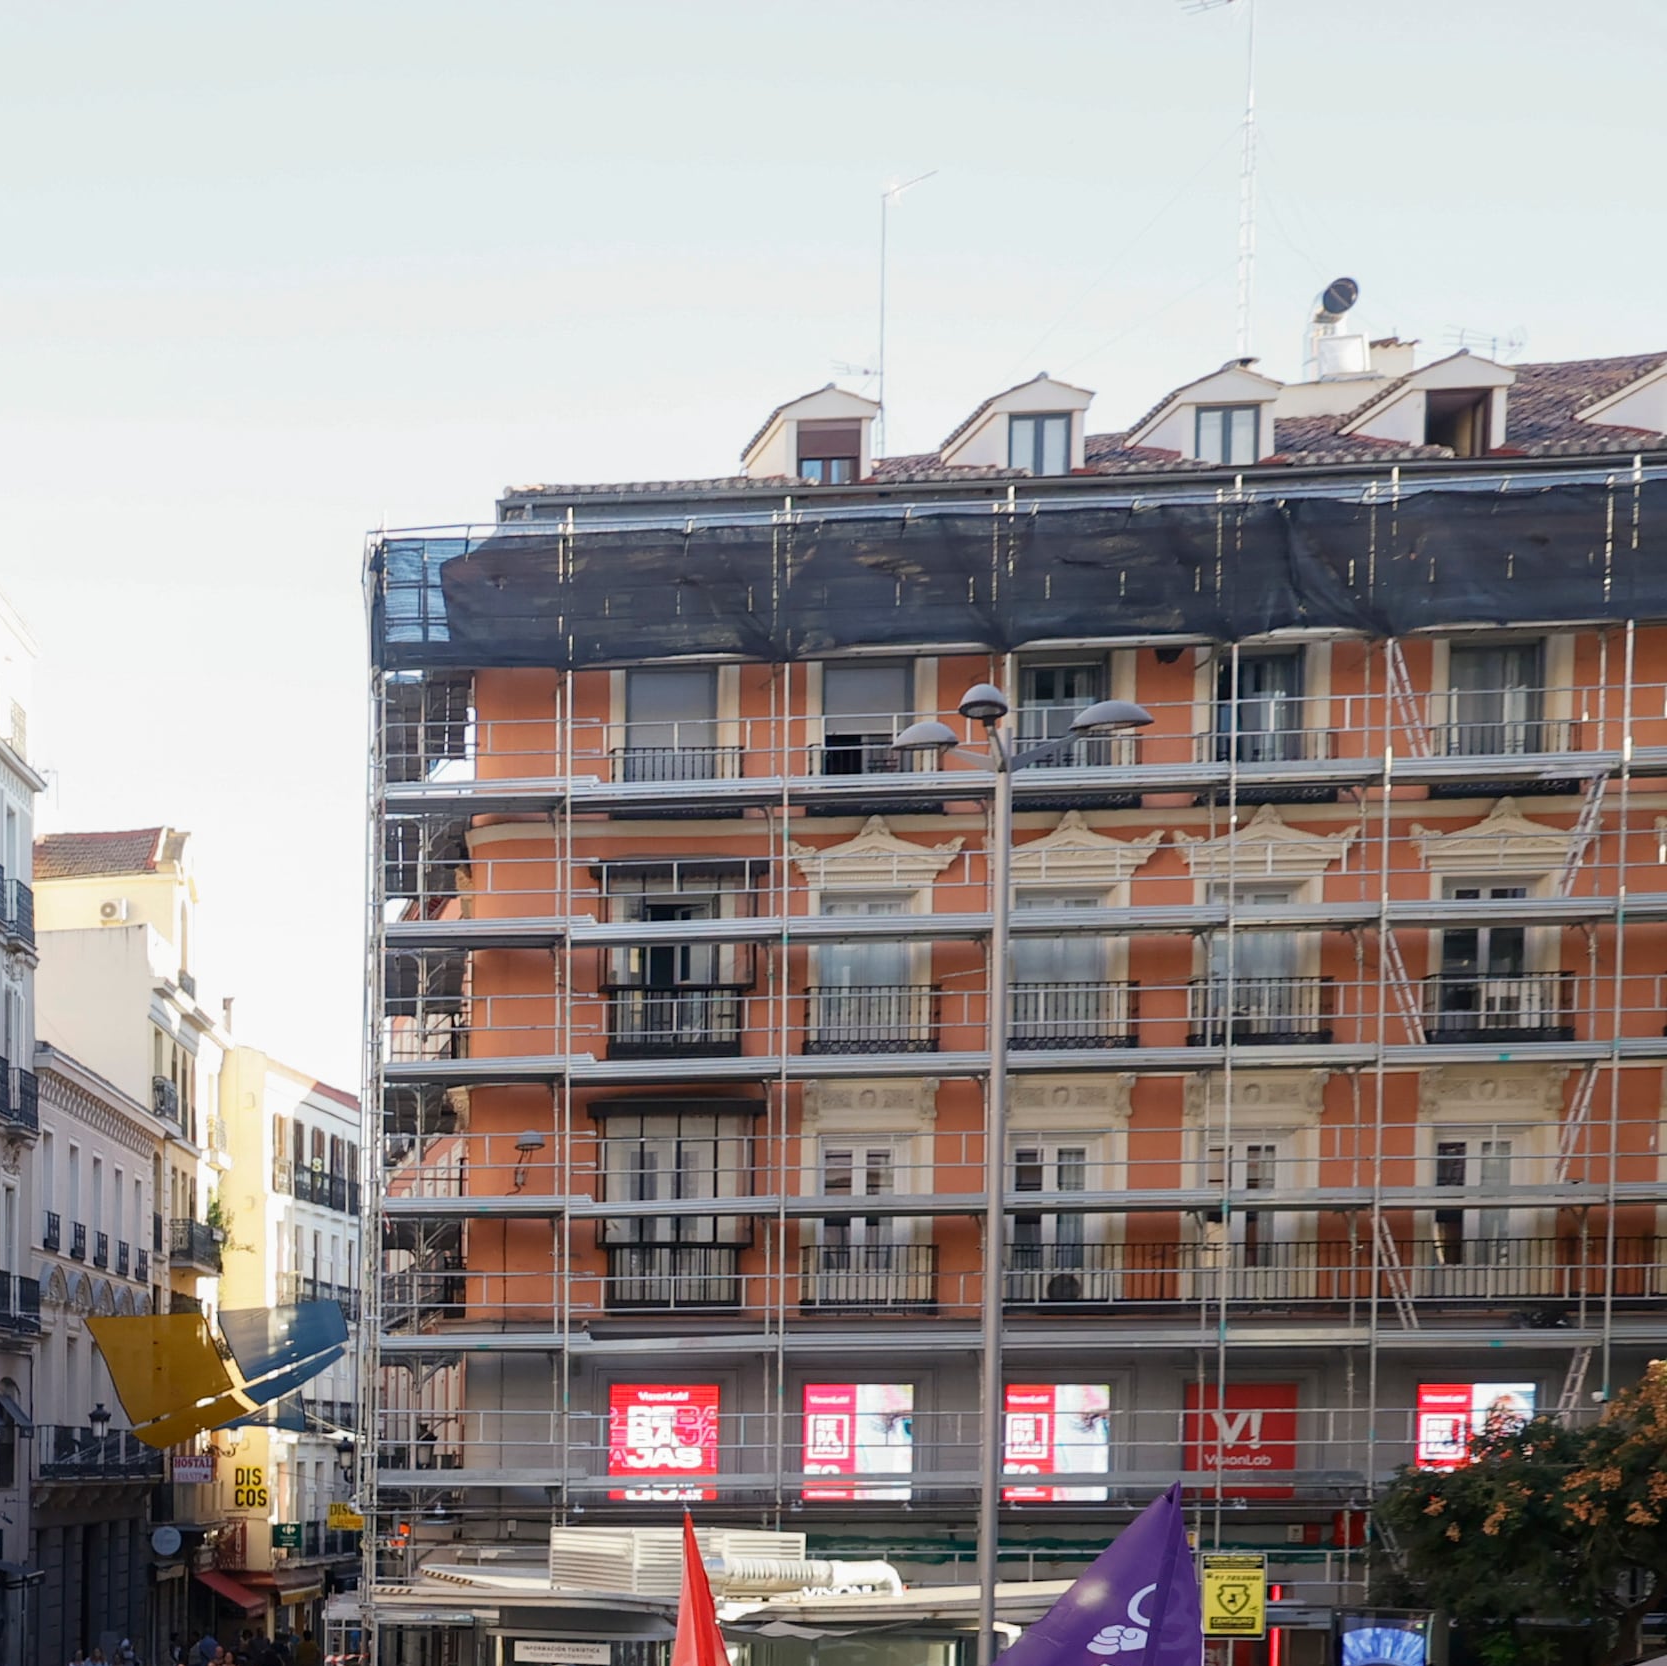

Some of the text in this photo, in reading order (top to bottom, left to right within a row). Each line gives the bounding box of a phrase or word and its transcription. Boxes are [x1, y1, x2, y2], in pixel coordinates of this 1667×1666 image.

[174, 1457, 213, 1468] HOSTAL
[626, 1448, 702, 1469] JAS
[235, 1468, 262, 1486] DIS
[235, 1489, 267, 1507] COS
